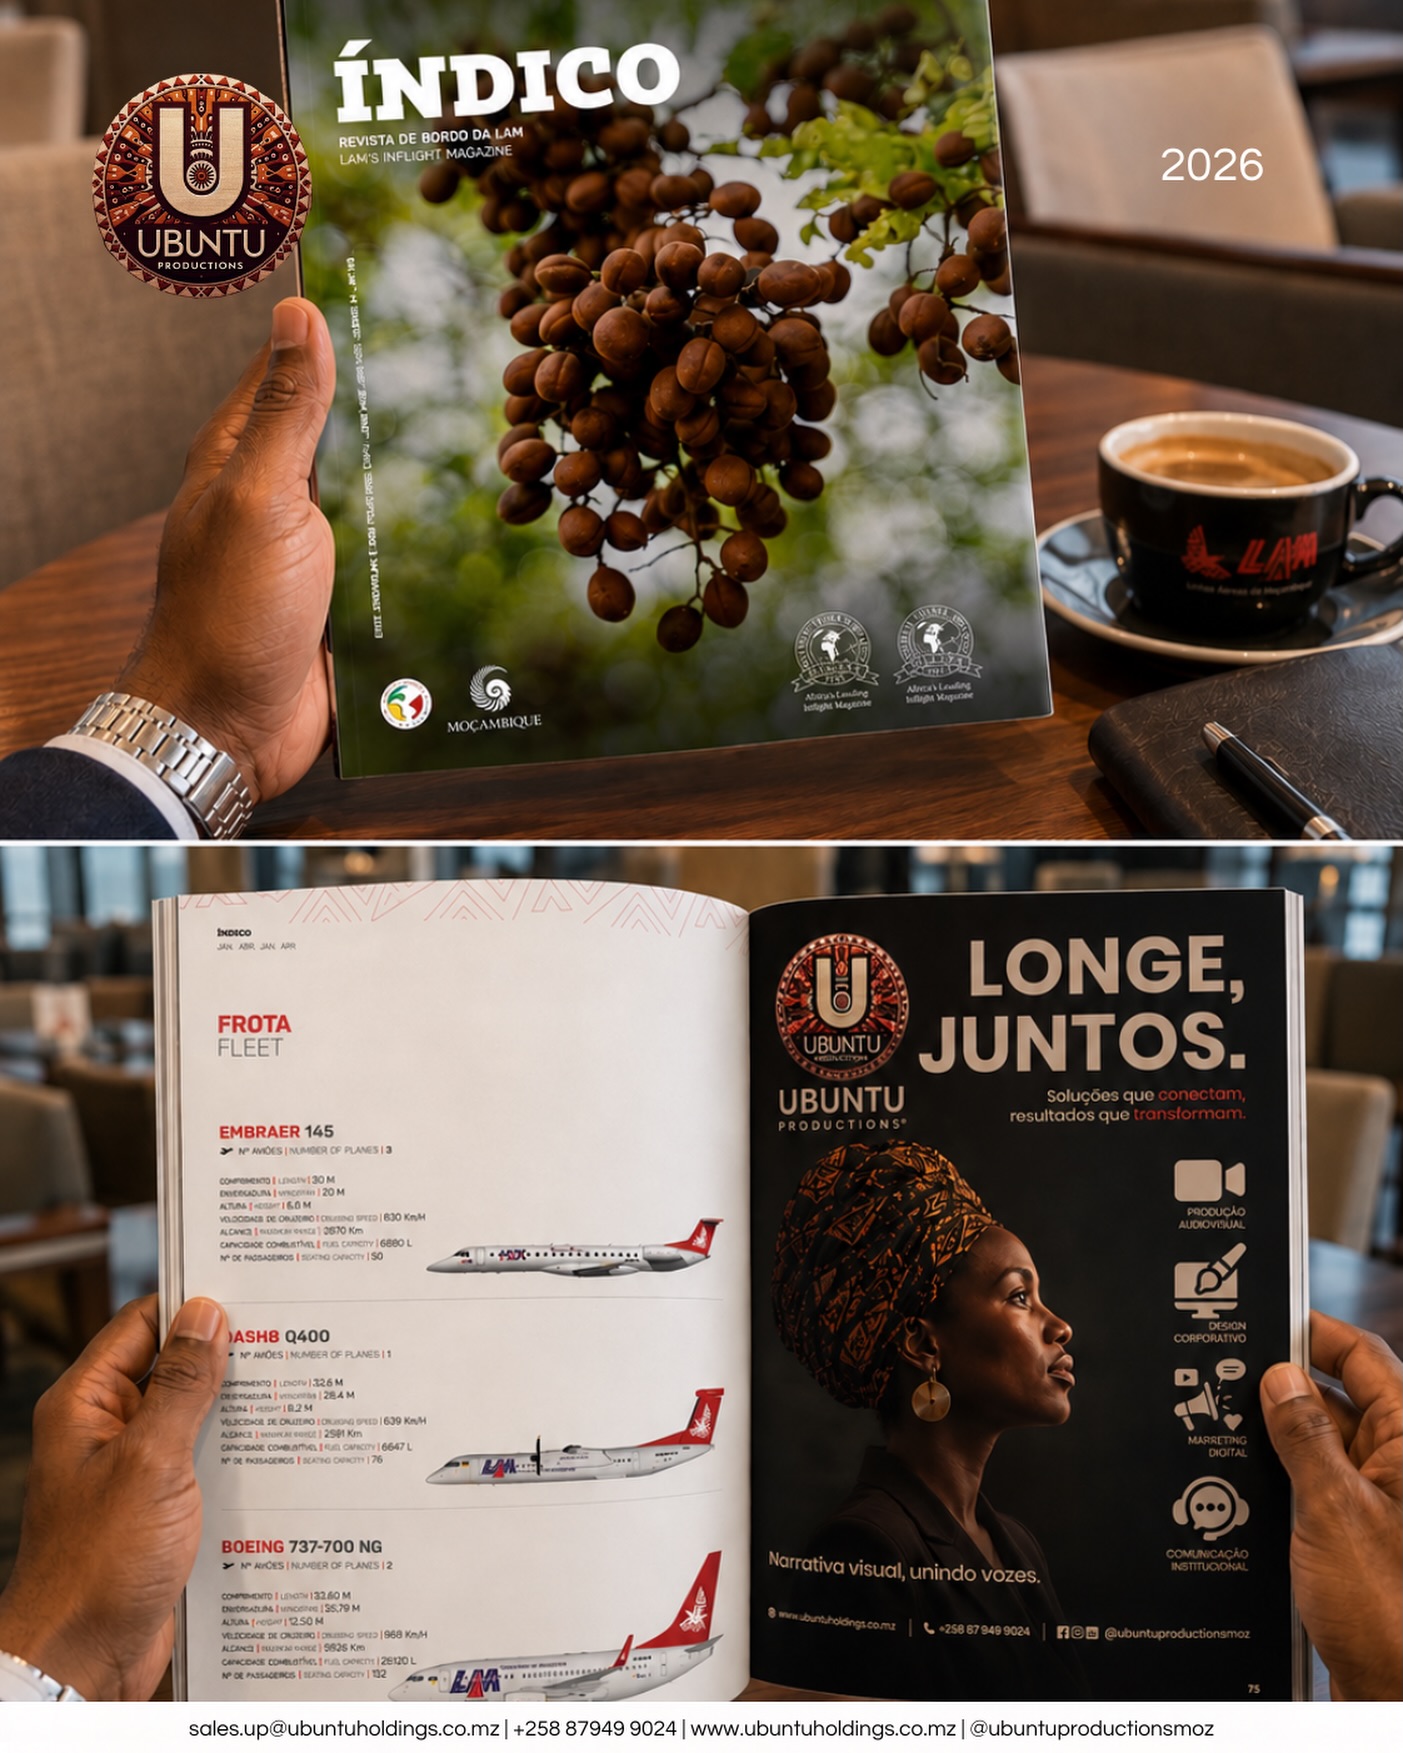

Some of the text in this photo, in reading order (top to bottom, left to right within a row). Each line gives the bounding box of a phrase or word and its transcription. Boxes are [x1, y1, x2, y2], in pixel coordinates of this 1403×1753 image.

[333, 39, 681, 123] ÍNDICO
[339, 126, 524, 148] REVISTA DE BORDO DA LAM
[339, 144, 513, 166] LAM'S INFLIGHT MAGAZINE
[1236, 531, 1318, 581] LAM
[447, 714, 542, 734] MOÇAMBIQUE
[970, 935, 1246, 1005] LONGE,
[218, 1014, 292, 1033] FROTA
[218, 1037, 284, 1057] FLEET
[804, 1034, 881, 1054] UBUNTU
[919, 1011, 1246, 1074] JUNTOS.
[778, 1085, 905, 1116] UBUNTU
[1047, 1087, 1246, 1106] Soluções que conectam,
[1010, 1106, 1247, 1125] resultados que transformam.
[219, 1124, 334, 1140] EMBRAER 145
[289, 1146, 329, 1155] NUMBER
[330, 1146, 342, 1155] OF
[344, 1146, 379, 1155] PLANES
[386, 1146, 392, 1155] 3
[312, 1175, 325, 1185] 30
[326, 1175, 336, 1185] M
[322, 1188, 335, 1197] 20
[336, 1188, 345, 1197] M
[303, 1201, 312, 1210] M
[1187, 1206, 1246, 1219] PRODUÇÃO
[349, 1227, 364, 1235] Km
[407, 1239, 413, 1247] L
[1208, 1321, 1247, 1331] DESIGN
[228, 1329, 330, 1345] ASH8 Q400
[1173, 1333, 1247, 1343] CORPORATIVO
[290, 1350, 329, 1359] NUMBER
[330, 1350, 343, 1359] OF
[345, 1350, 380, 1358] PLANES
[387, 1350, 392, 1358] 1
[334, 1378, 344, 1387] M
[346, 1390, 355, 1399] M
[303, 1404, 313, 1412] M
[403, 1416, 427, 1426] Km/H
[347, 1429, 363, 1438] Km
[406, 1442, 413, 1451] L
[1208, 1448, 1248, 1458] DIGITAL
[371, 1455, 383, 1464] 76
[481, 1458, 518, 1478] LAM
[221, 1539, 383, 1554] BOEING 737-700 NG
[1166, 1547, 1249, 1560] COMUNICAÇÃO
[291, 1561, 330, 1570] NUMBER
[331, 1561, 343, 1570] OF
[386, 1561, 393, 1570] 2
[768, 1550, 1042, 1585] Narrativa visual, unindo vozes.
[1171, 1562, 1249, 1572] INSTITUCIONAL
[341, 1591, 351, 1601] M
[351, 1604, 360, 1613] M
[314, 1617, 324, 1626] M
[404, 1630, 428, 1640] Km/H
[939, 1623, 965, 1635] +258
[966, 1624, 979, 1635] 87
[1003, 1624, 1031, 1637] 9024
[1104, 1627, 1251, 1641] @ubuntuproductionsmoz
[350, 1643, 366, 1652] Km
[410, 1656, 417, 1665] L
[449, 1668, 501, 1699] LAM
[1247, 1684, 1261, 1694] 75
